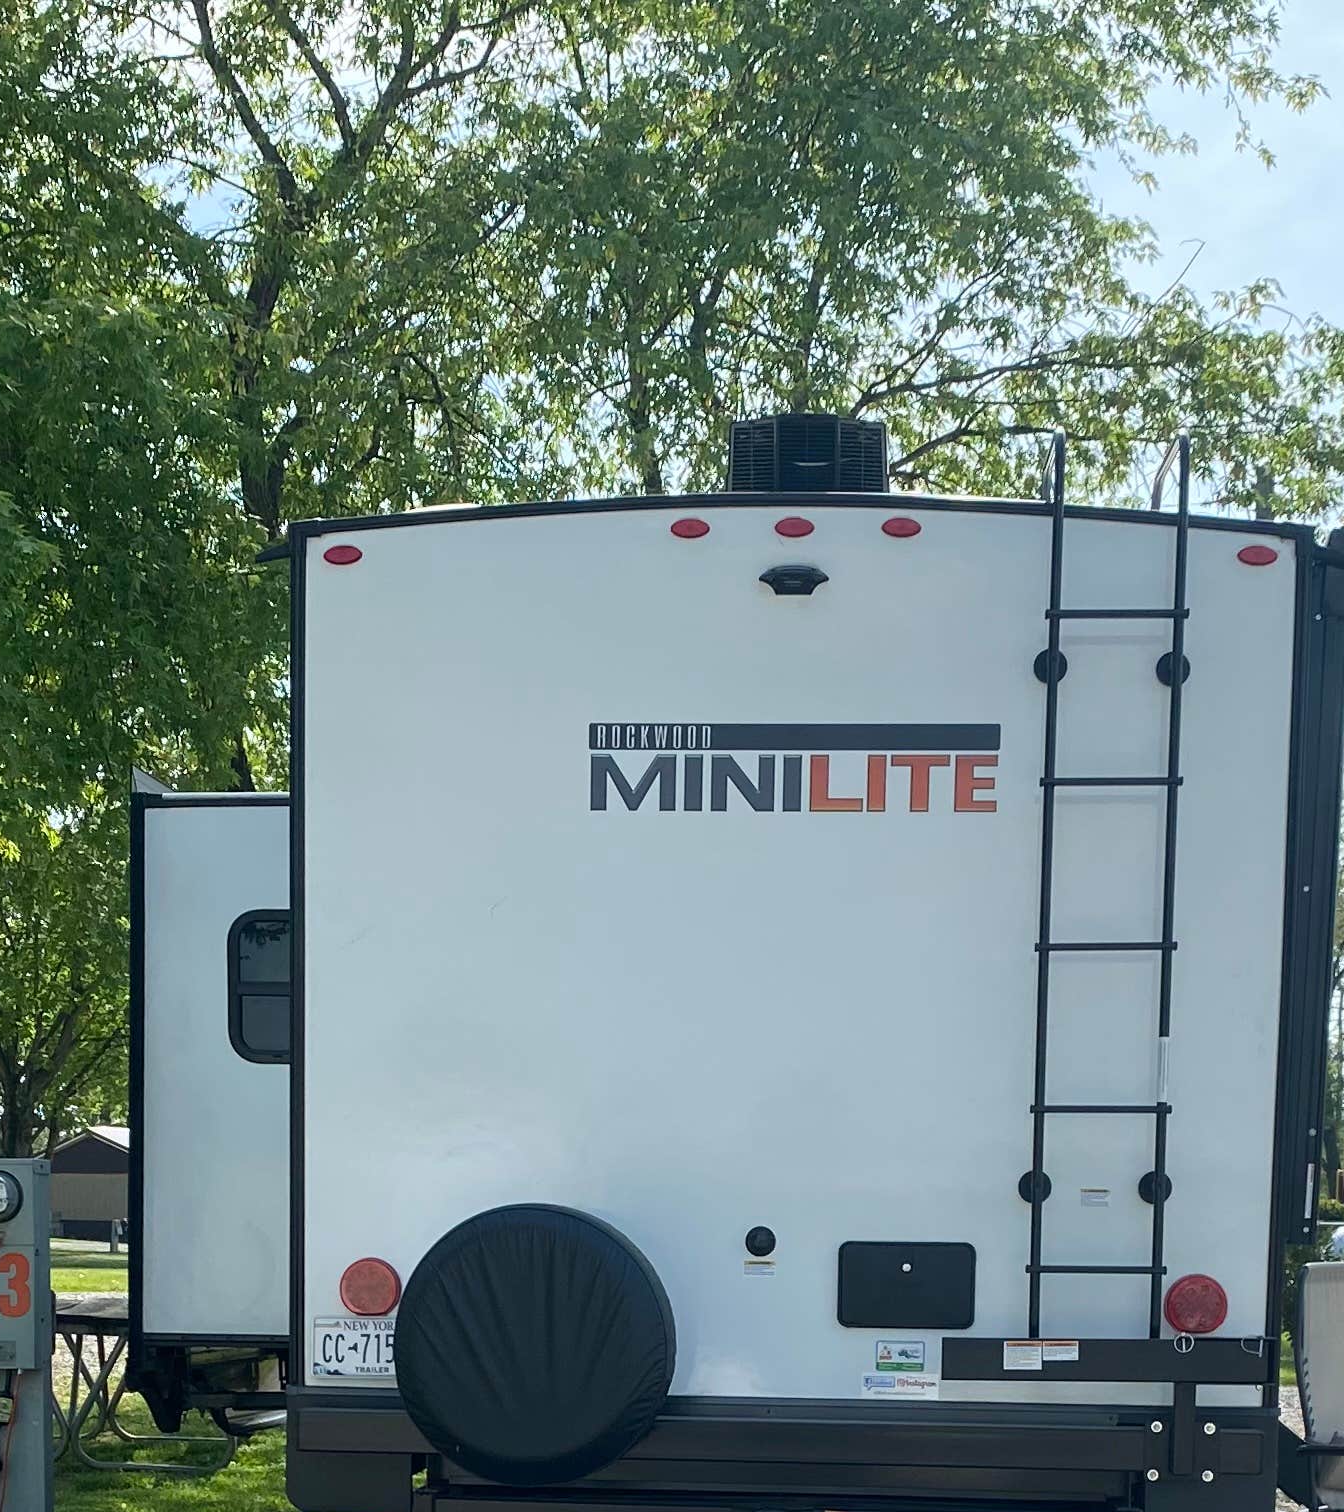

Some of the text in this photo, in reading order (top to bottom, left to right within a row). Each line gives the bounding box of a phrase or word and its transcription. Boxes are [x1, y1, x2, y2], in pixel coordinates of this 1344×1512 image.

[597, 724, 712, 749] ROCKWOOD
[590, 754, 999, 813] MINILITE
[343, 1321, 394, 1331] NEW YOR
[323, 1333, 395, 1363] CC 715
